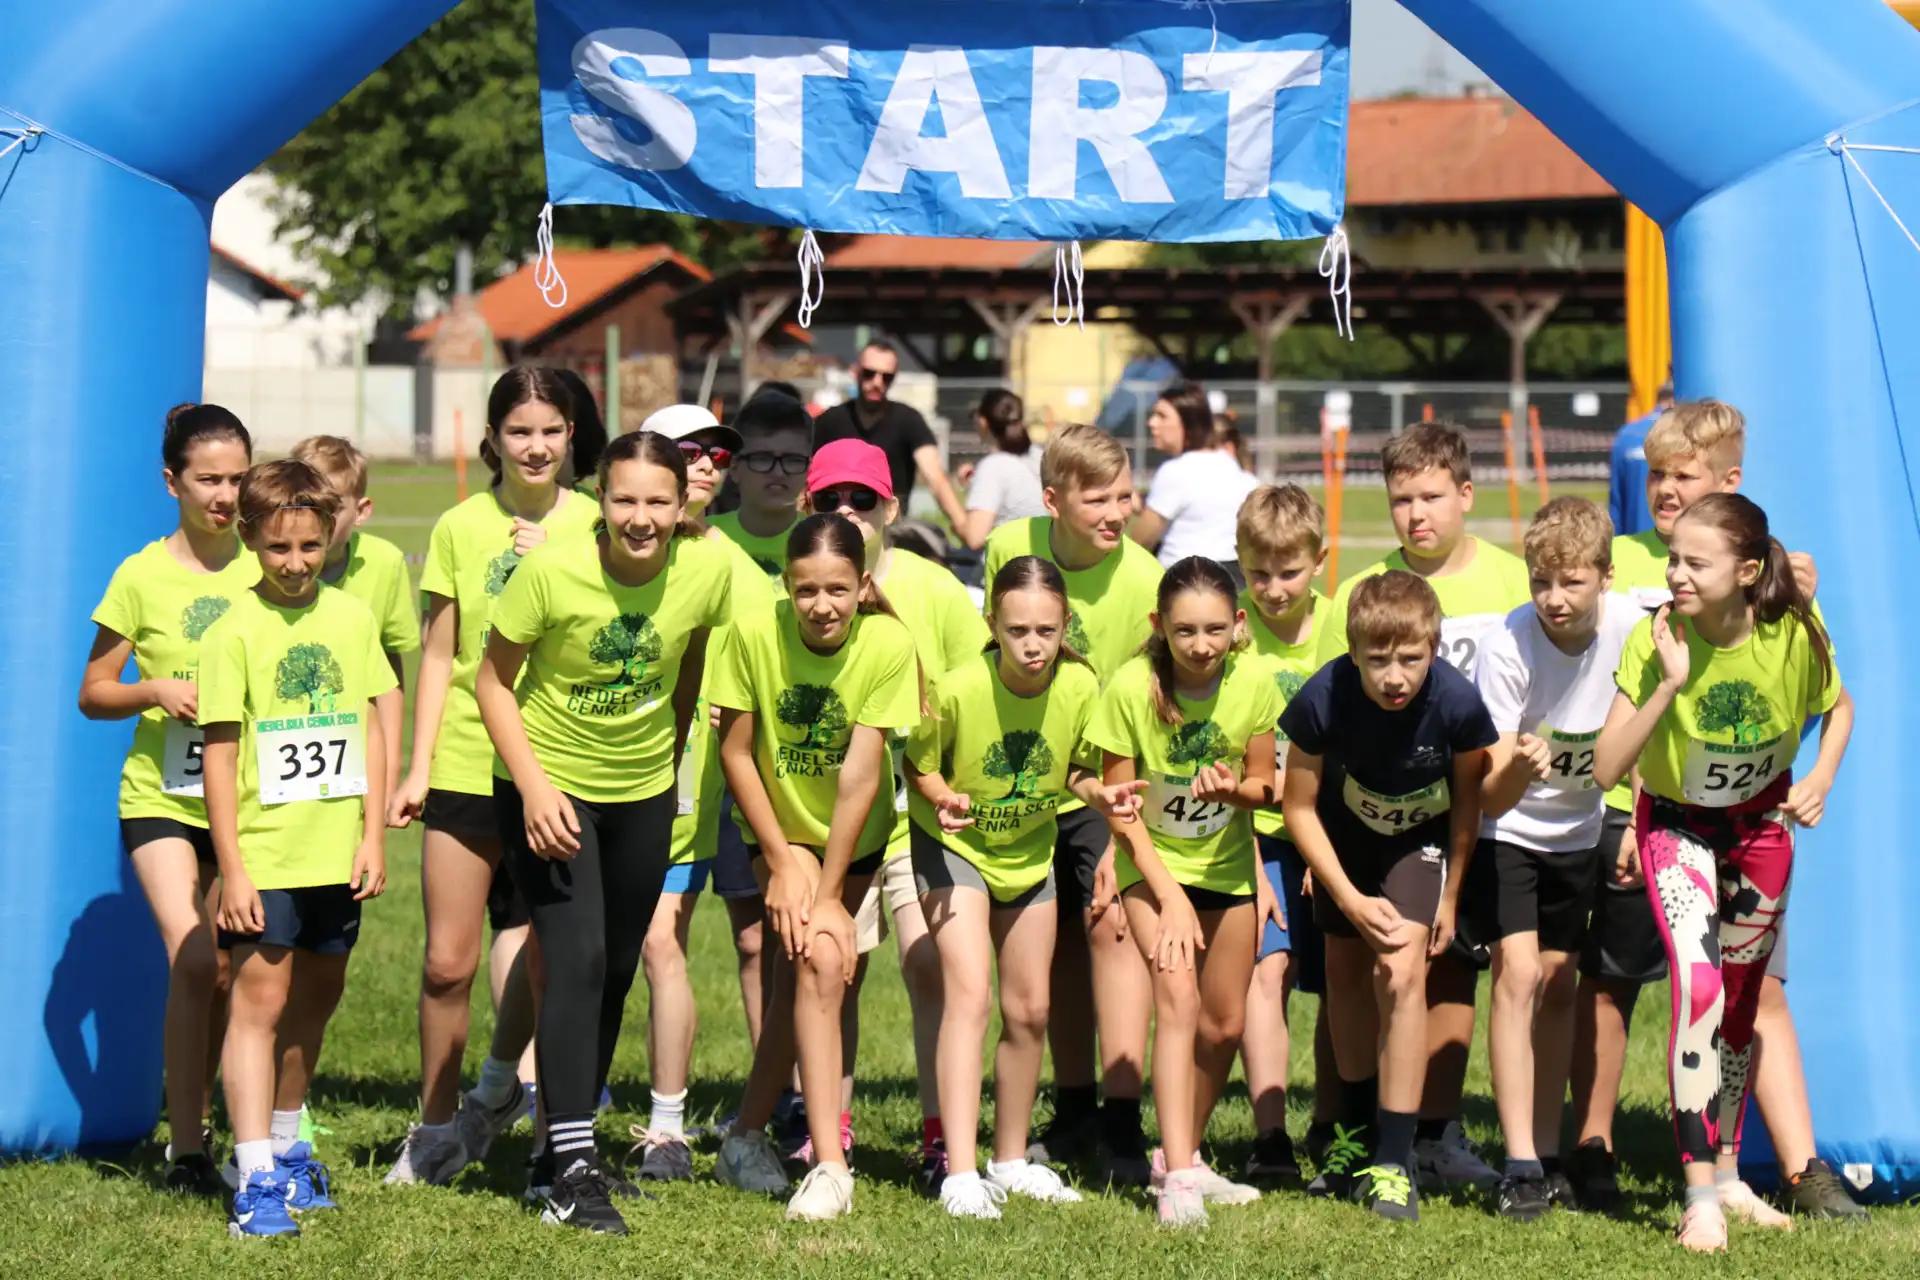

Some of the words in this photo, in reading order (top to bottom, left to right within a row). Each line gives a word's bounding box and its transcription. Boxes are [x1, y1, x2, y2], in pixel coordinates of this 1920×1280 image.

[570, 27, 1322, 203] START
[279, 739, 347, 781] 337
[1704, 754, 1775, 791] 524
[1360, 800, 1431, 826] 546
